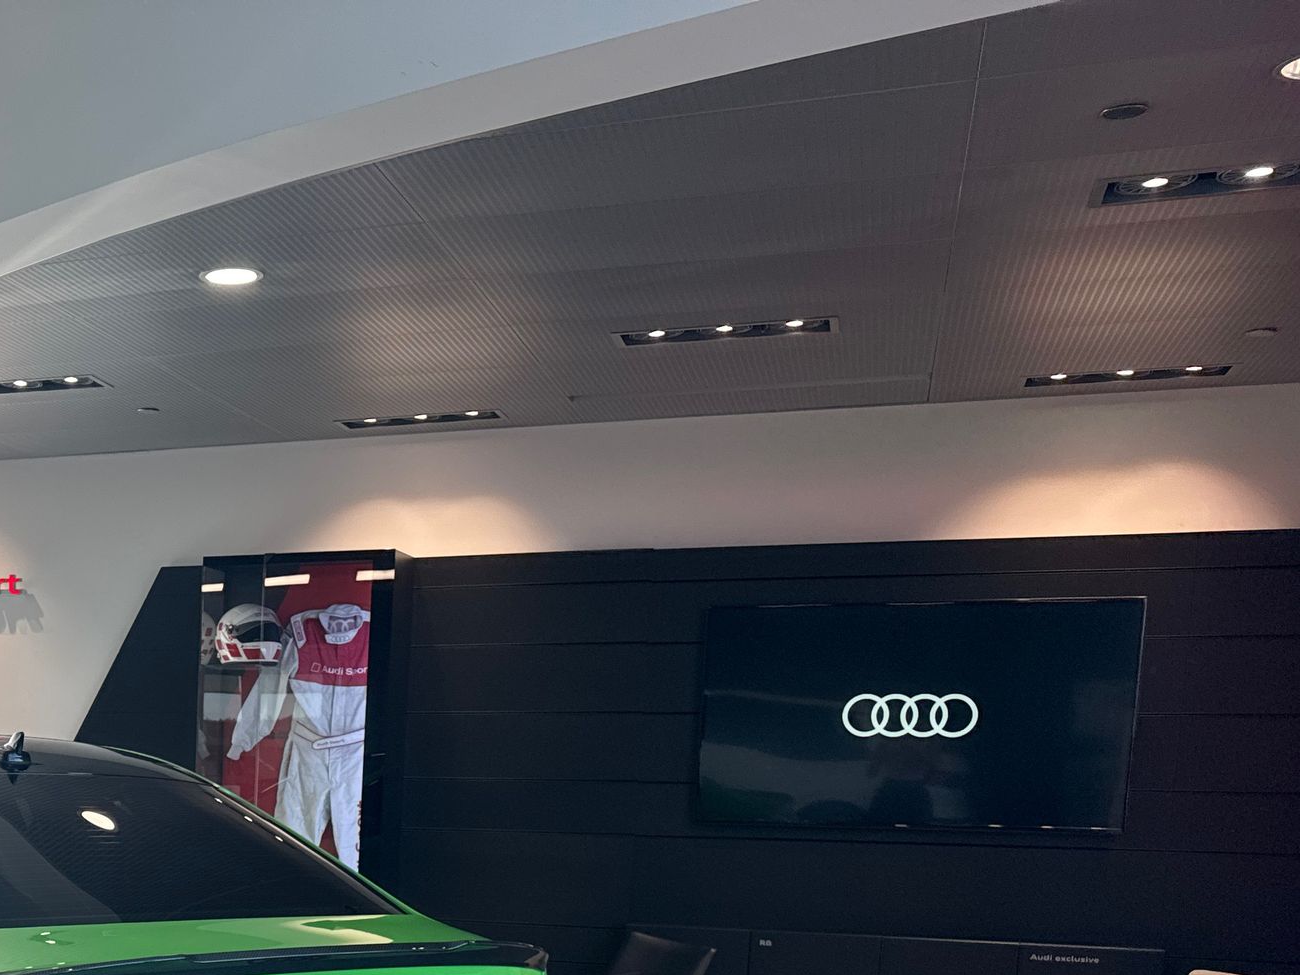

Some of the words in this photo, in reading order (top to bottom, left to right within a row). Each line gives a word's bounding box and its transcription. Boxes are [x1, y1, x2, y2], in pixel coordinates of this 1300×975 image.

[322, 665, 344, 676] Audi
[1029, 953, 1053, 961] Audi
[1054, 955, 1100, 964] exclusive
